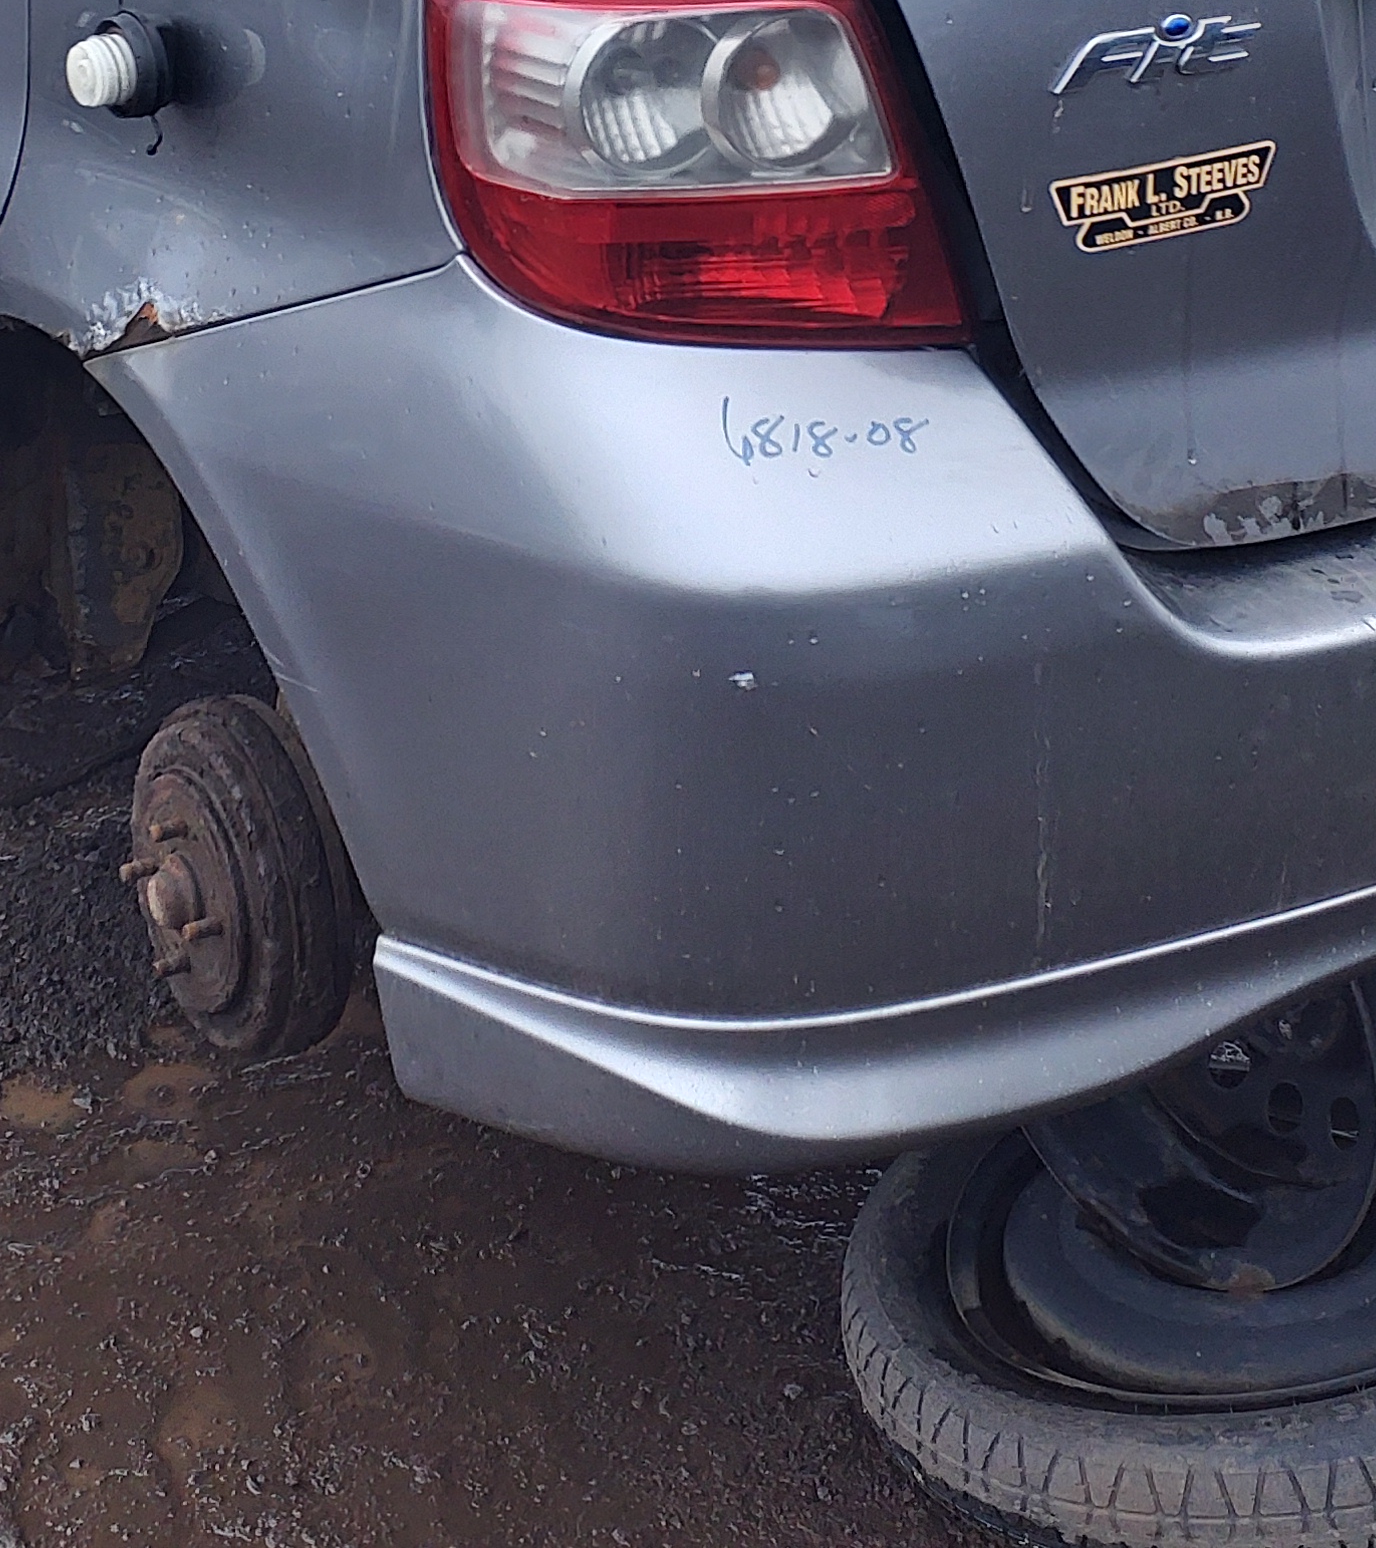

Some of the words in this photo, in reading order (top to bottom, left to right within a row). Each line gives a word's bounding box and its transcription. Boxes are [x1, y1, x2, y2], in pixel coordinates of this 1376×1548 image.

[1069, 178, 1141, 218] FRANK
[1145, 173, 1168, 204] L.
[1172, 154, 1262, 199] STEEVES
[1150, 199, 1187, 217] LTD.
[722, 395, 930, 466] 6818-08
